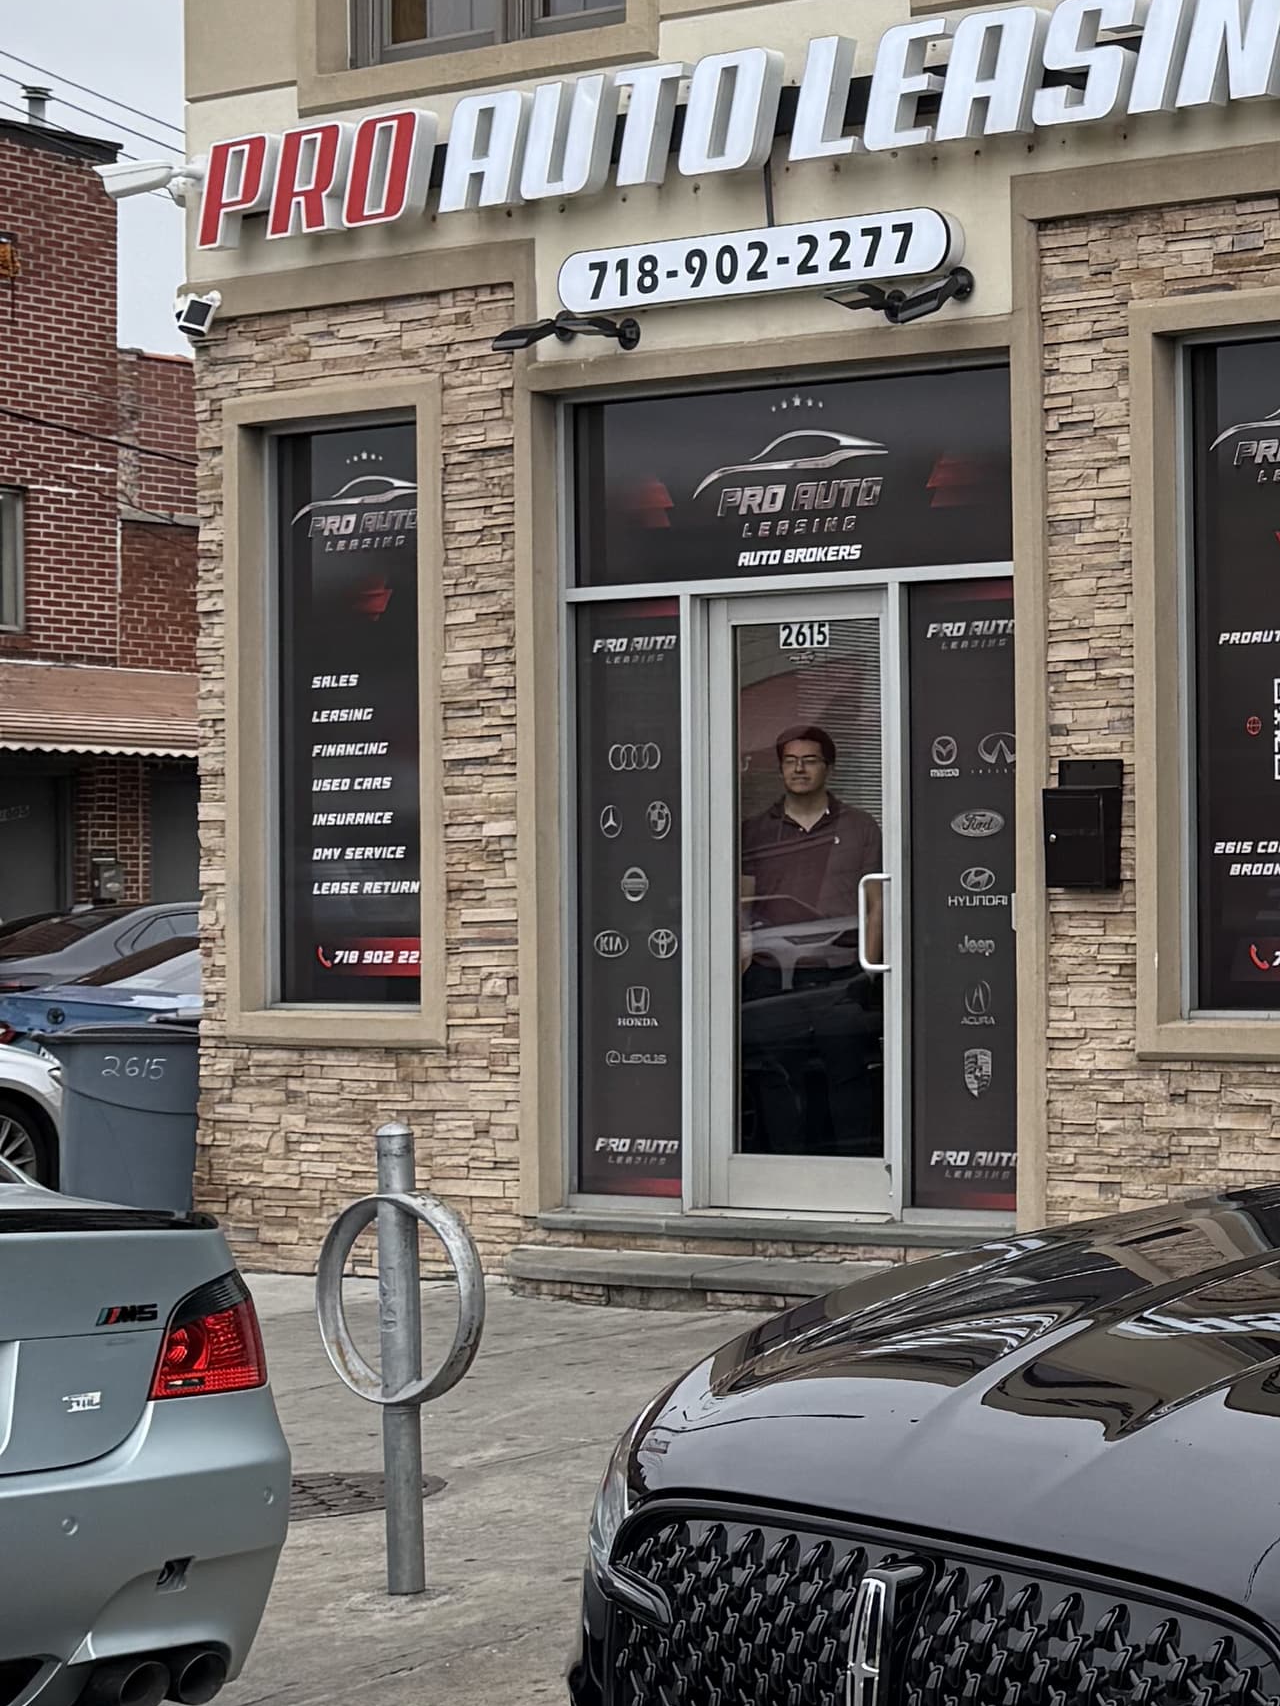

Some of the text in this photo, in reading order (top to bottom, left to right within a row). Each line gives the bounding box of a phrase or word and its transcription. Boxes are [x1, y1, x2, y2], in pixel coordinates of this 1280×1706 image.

[197, 108, 436, 250] PRO
[439, 47, 786, 213] AUTO
[588, 222, 913, 300] 718-902-2277
[717, 477, 884, 517] PRO AUTO
[308, 514, 357, 537] PRO
[742, 515, 857, 538] LEASING
[325, 536, 406, 552] LEASING
[738, 544, 862, 567] AUTO BROKERS
[782, 623, 828, 647] 2615
[926, 622, 967, 638] PRO
[592, 635, 677, 653] PRO AUTO
[312, 674, 359, 688] SALES
[312, 708, 374, 723] LEASING
[312, 742, 389, 757] FINANCING
[312, 777, 392, 791] USED CARS
[312, 812, 394, 826] INSURANCE
[962, 814, 993, 832] Ford
[312, 846, 406, 860] DMV SERVICE
[1214, 841, 1253, 854] 2615
[312, 882, 360, 895] LEASE
[948, 895, 1008, 907] HYUNDAI
[600, 936, 623, 951] KIA
[958, 935, 996, 956] Jeep
[334, 950, 422, 964] 718 902 22
[618, 1017, 658, 1026] HONDA
[622, 1054, 667, 1064] LEXUS
[101, 1056, 167, 1080] 2615
[595, 1138, 679, 1154] PRO AUTO
[930, 1150, 970, 1166] PRO
[112, 1303, 158, 1323] M5
